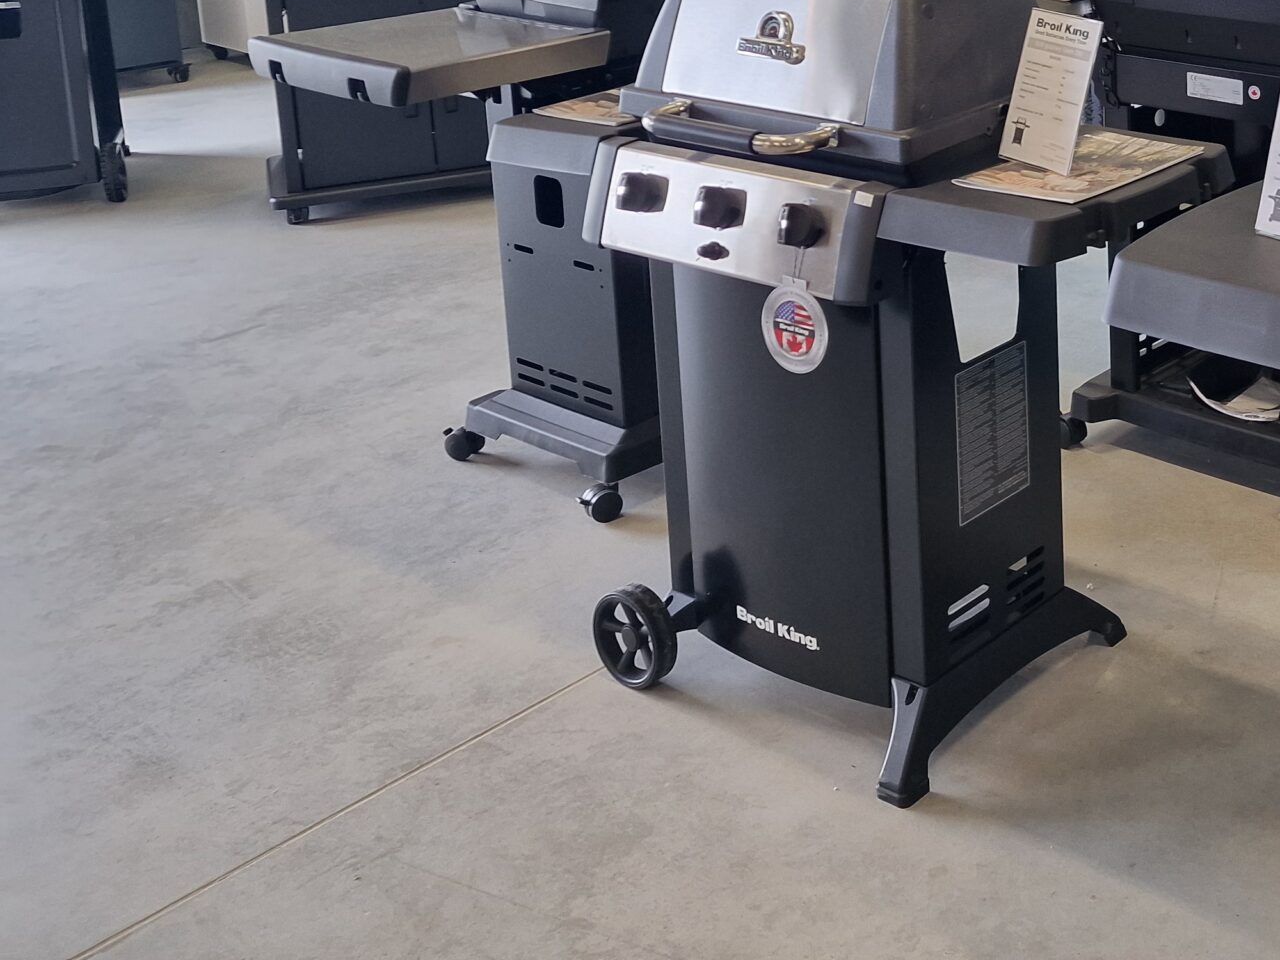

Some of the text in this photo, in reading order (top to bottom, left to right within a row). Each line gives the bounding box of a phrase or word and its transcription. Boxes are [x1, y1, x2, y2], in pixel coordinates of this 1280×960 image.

[1036, 17, 1090, 41] Broil King
[736, 604, 818, 651] Broil King
